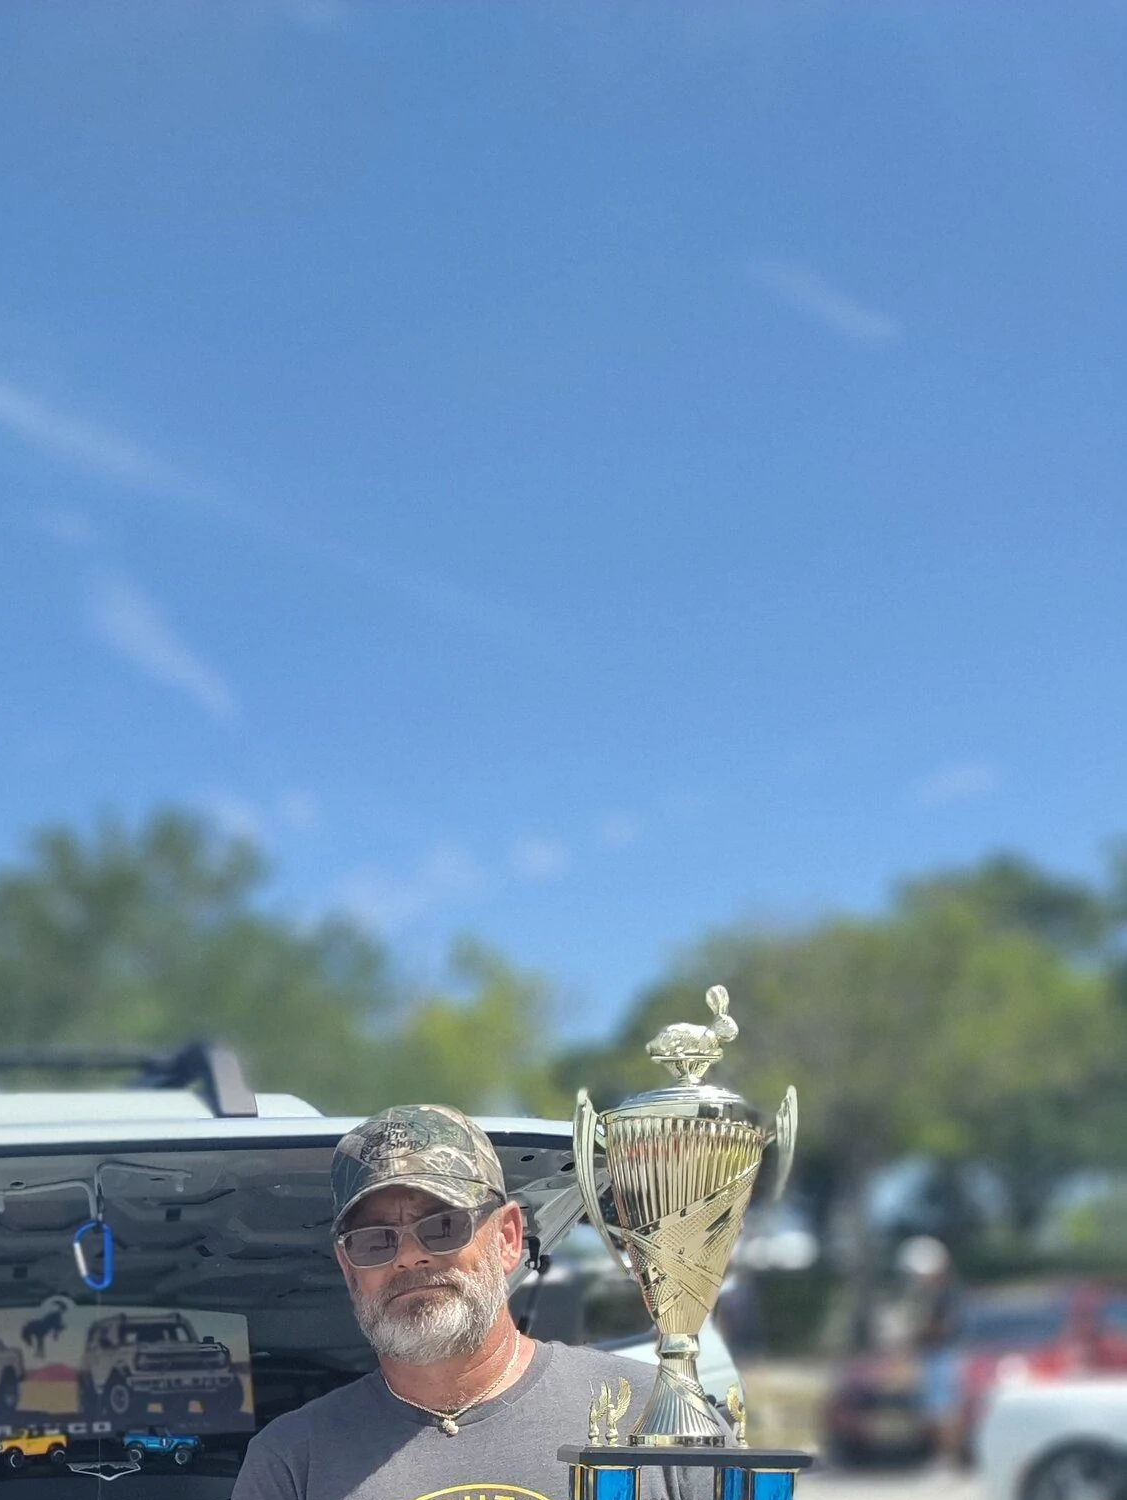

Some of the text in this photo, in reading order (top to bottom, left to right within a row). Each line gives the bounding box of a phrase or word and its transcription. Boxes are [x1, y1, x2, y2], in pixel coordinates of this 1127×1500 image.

[383, 1121, 415, 1133] Bass
[386, 1130, 409, 1140] Pro
[388, 1138, 424, 1151] Shops
